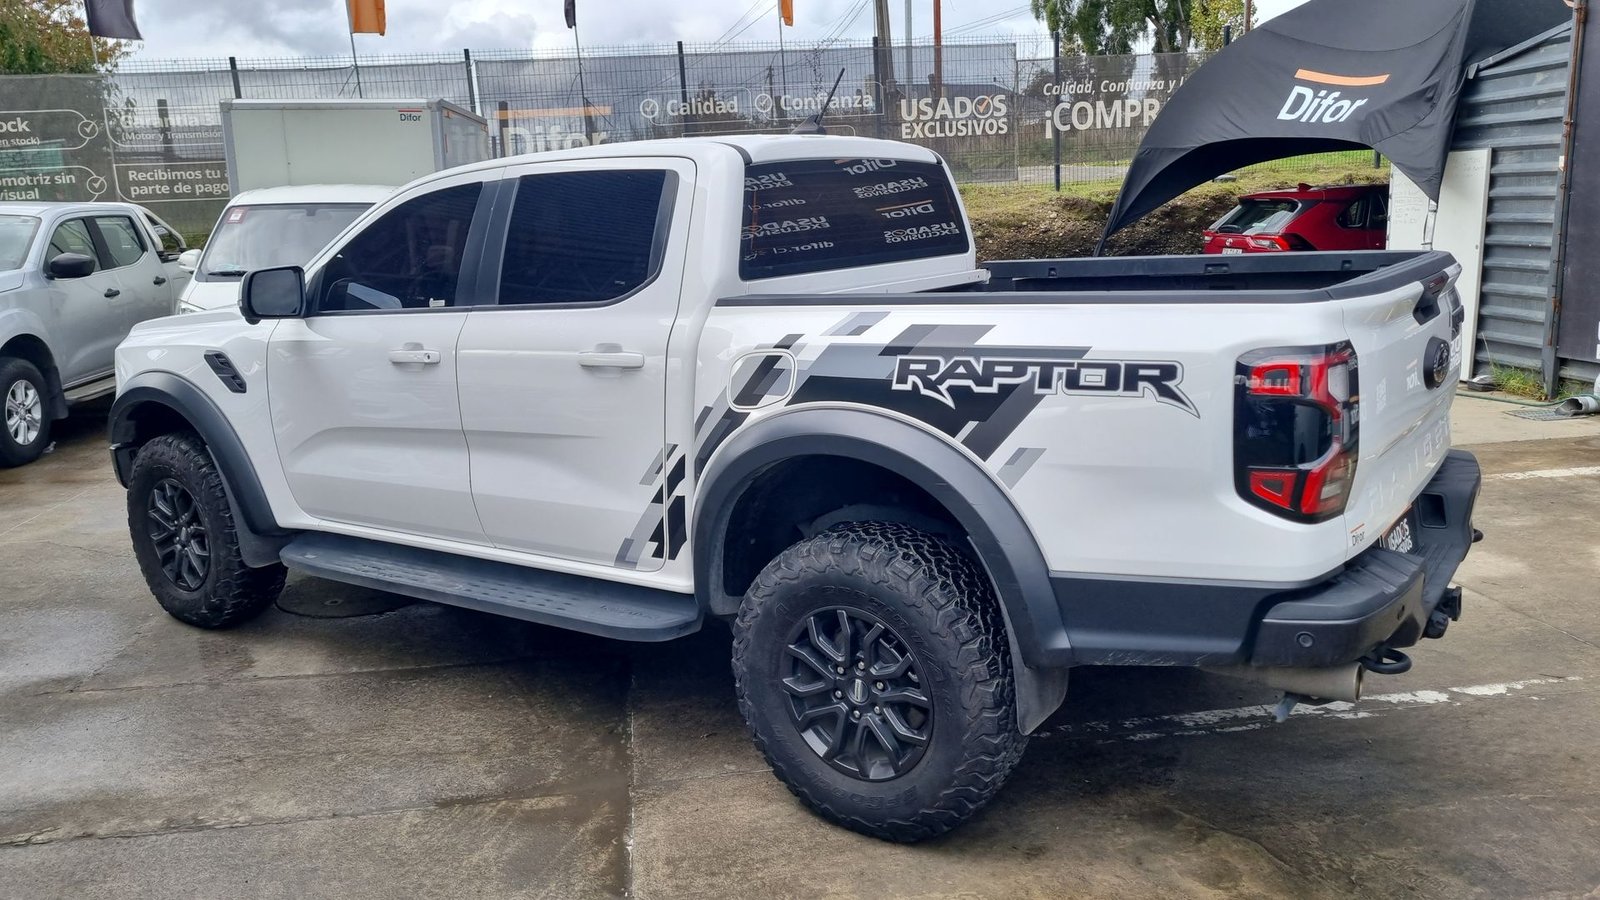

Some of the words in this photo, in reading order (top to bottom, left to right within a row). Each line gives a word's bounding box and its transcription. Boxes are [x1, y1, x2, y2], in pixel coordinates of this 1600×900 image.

[1043, 79, 1095, 96] Calidad,
[1100, 78, 1164, 94] Confianza
[1167, 79, 1176, 93] y
[666, 96, 738, 116] Calidad
[781, 92, 873, 111] Confianza
[900, 94, 1007, 121] USADOS
[1277, 85, 1368, 123] Difor
[399, 113, 422, 122] Difor
[1044, 98, 1163, 139] ¡COMPR
[901, 117, 1008, 139] EXCLUSIVOS
[0, 173, 52, 186] motriz
[54, 172, 76, 184] sin
[128, 169, 203, 181] Recibimos
[205, 169, 221, 178] tu
[130, 184, 170, 198] parte
[173, 182, 192, 193] de
[195, 182, 229, 196] pago
[892, 355, 1200, 419] RAPTOR
